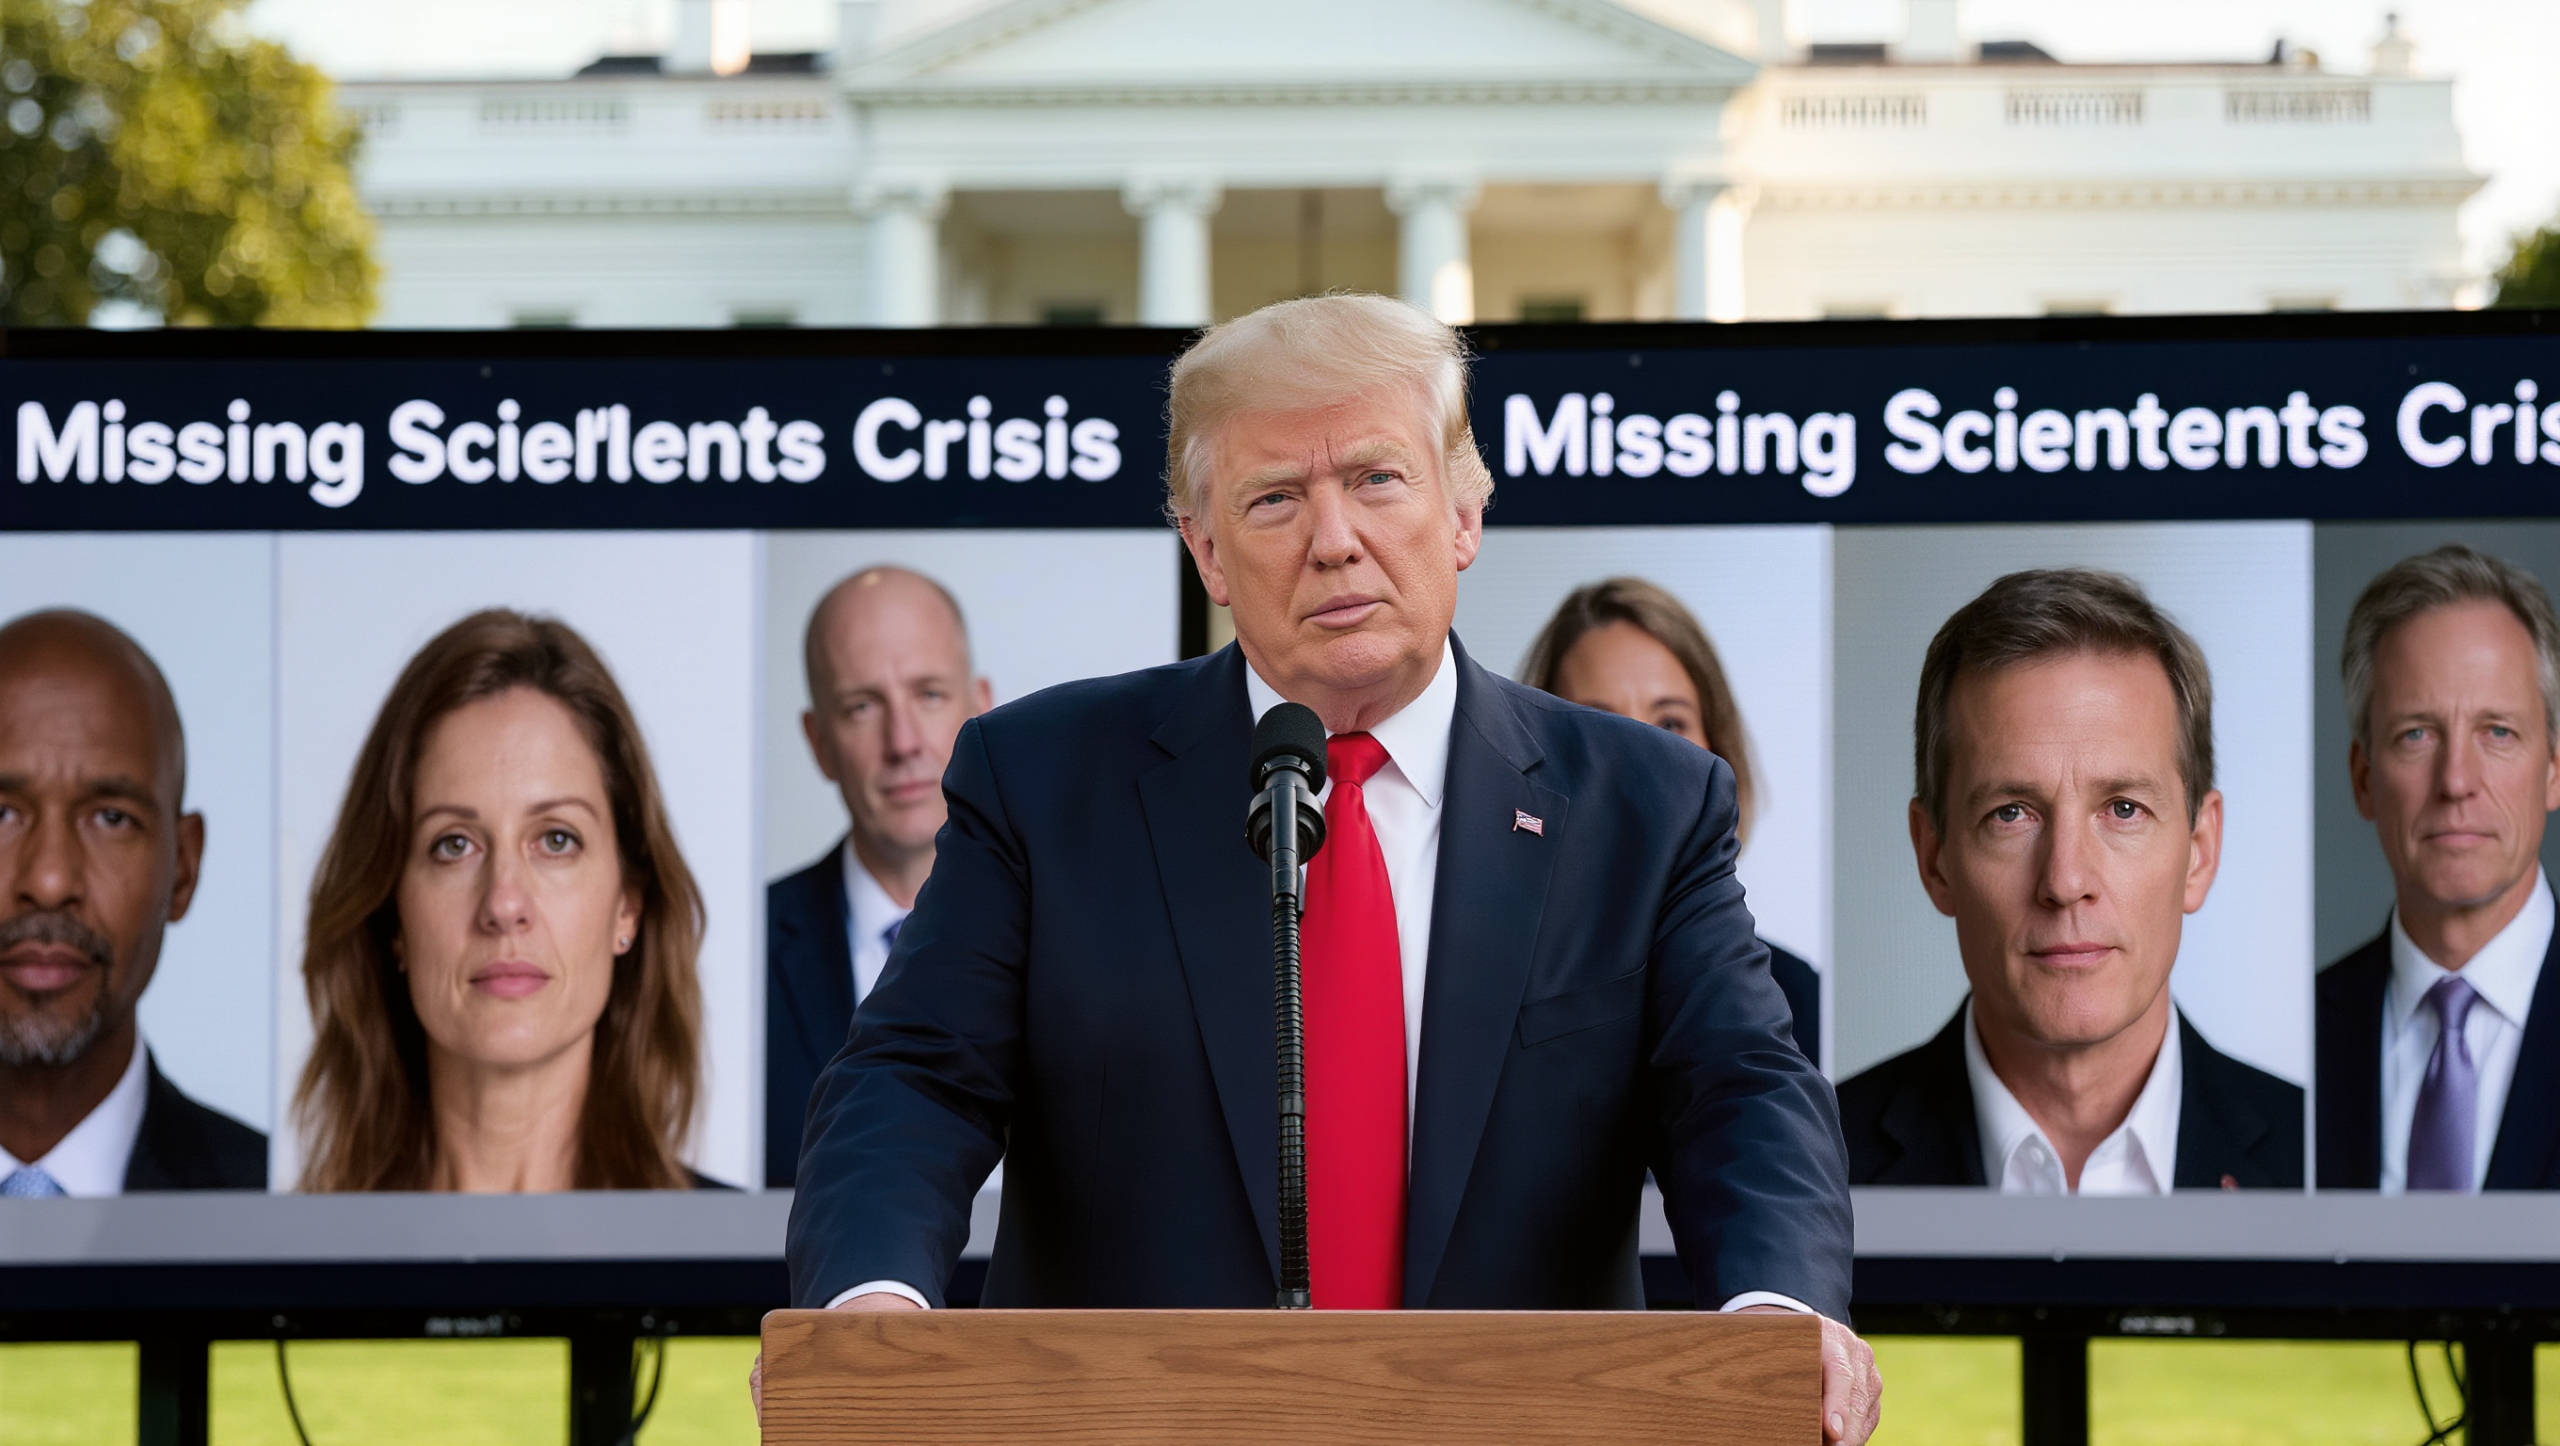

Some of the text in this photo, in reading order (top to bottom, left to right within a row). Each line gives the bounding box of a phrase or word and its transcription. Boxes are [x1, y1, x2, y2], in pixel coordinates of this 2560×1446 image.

[17, 399, 364, 507] Missing
[853, 395, 1121, 482] Crisis
[1504, 390, 1856, 497] Missing
[1884, 387, 2368, 474] Scientents
